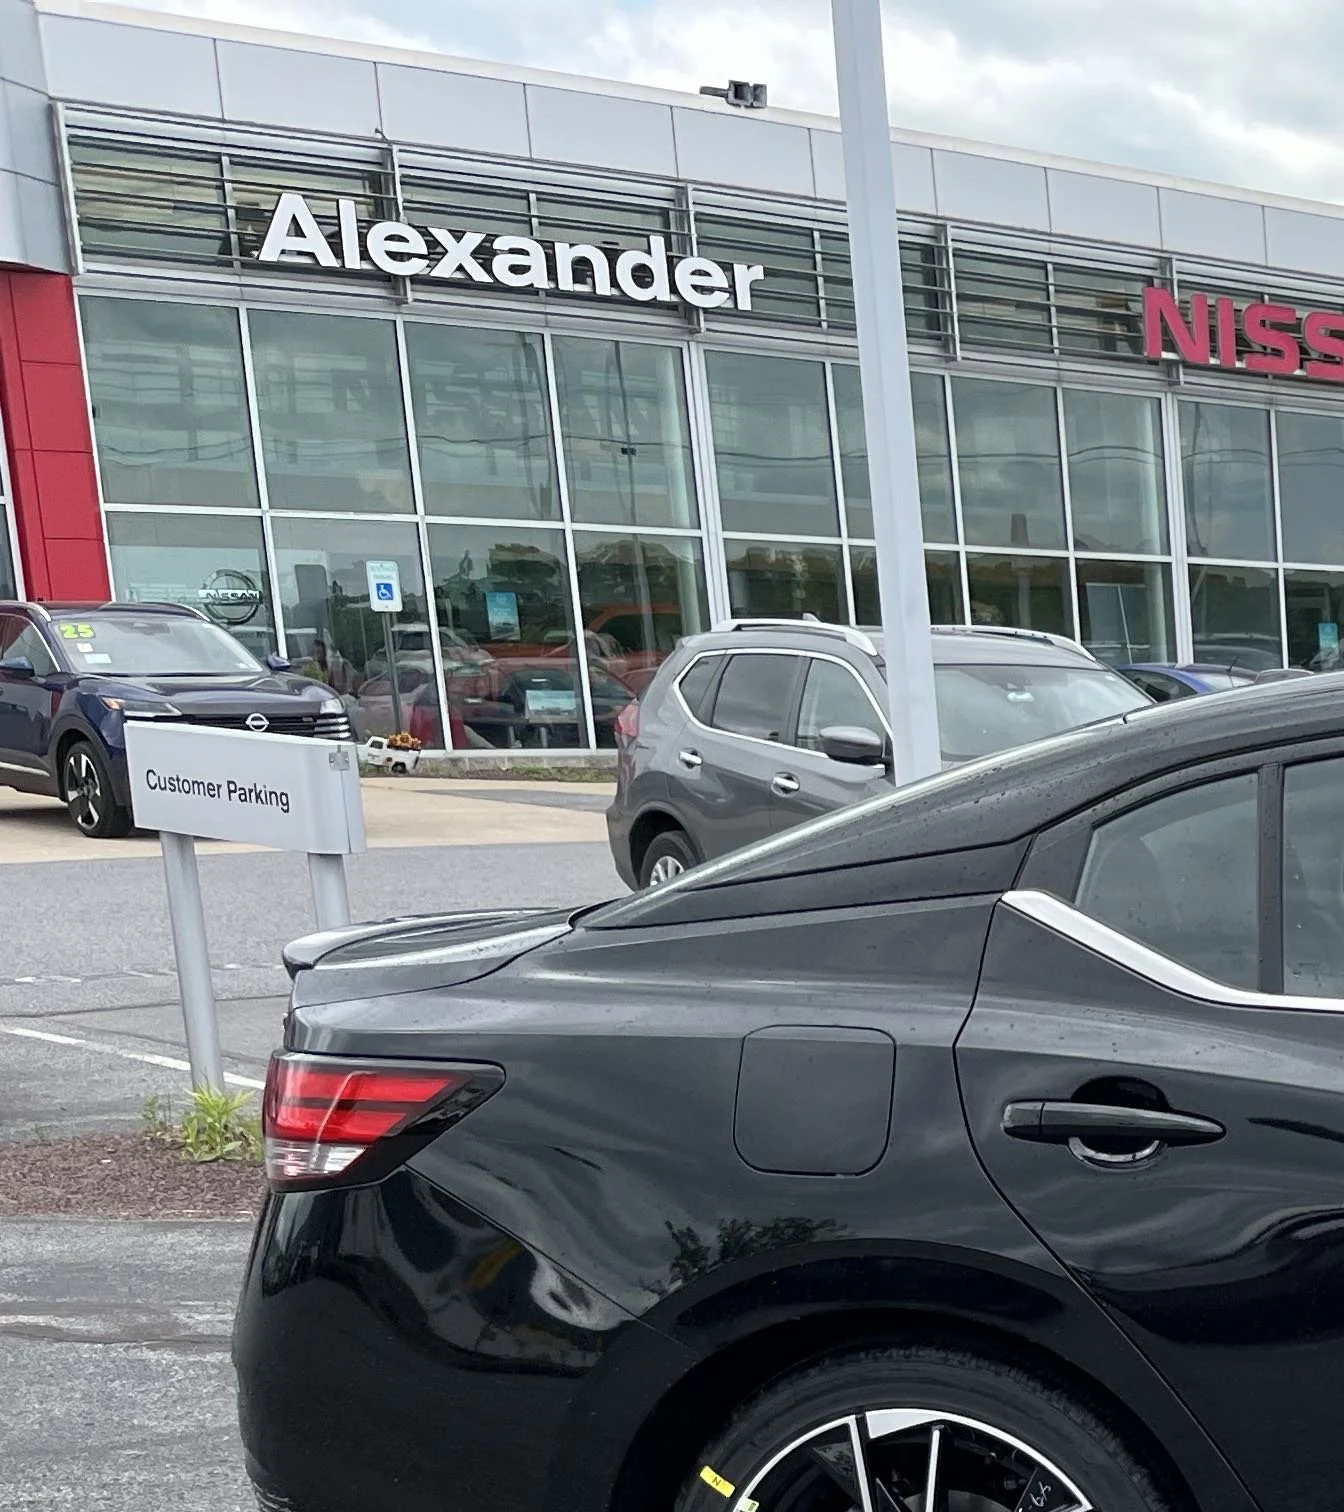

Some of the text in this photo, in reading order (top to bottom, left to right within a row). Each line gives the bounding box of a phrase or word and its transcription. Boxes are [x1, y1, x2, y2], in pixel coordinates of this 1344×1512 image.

[256, 191, 765, 312] Alexander
[60, 623, 94, 639] 25
[145, 768, 290, 814] Customer Parking
